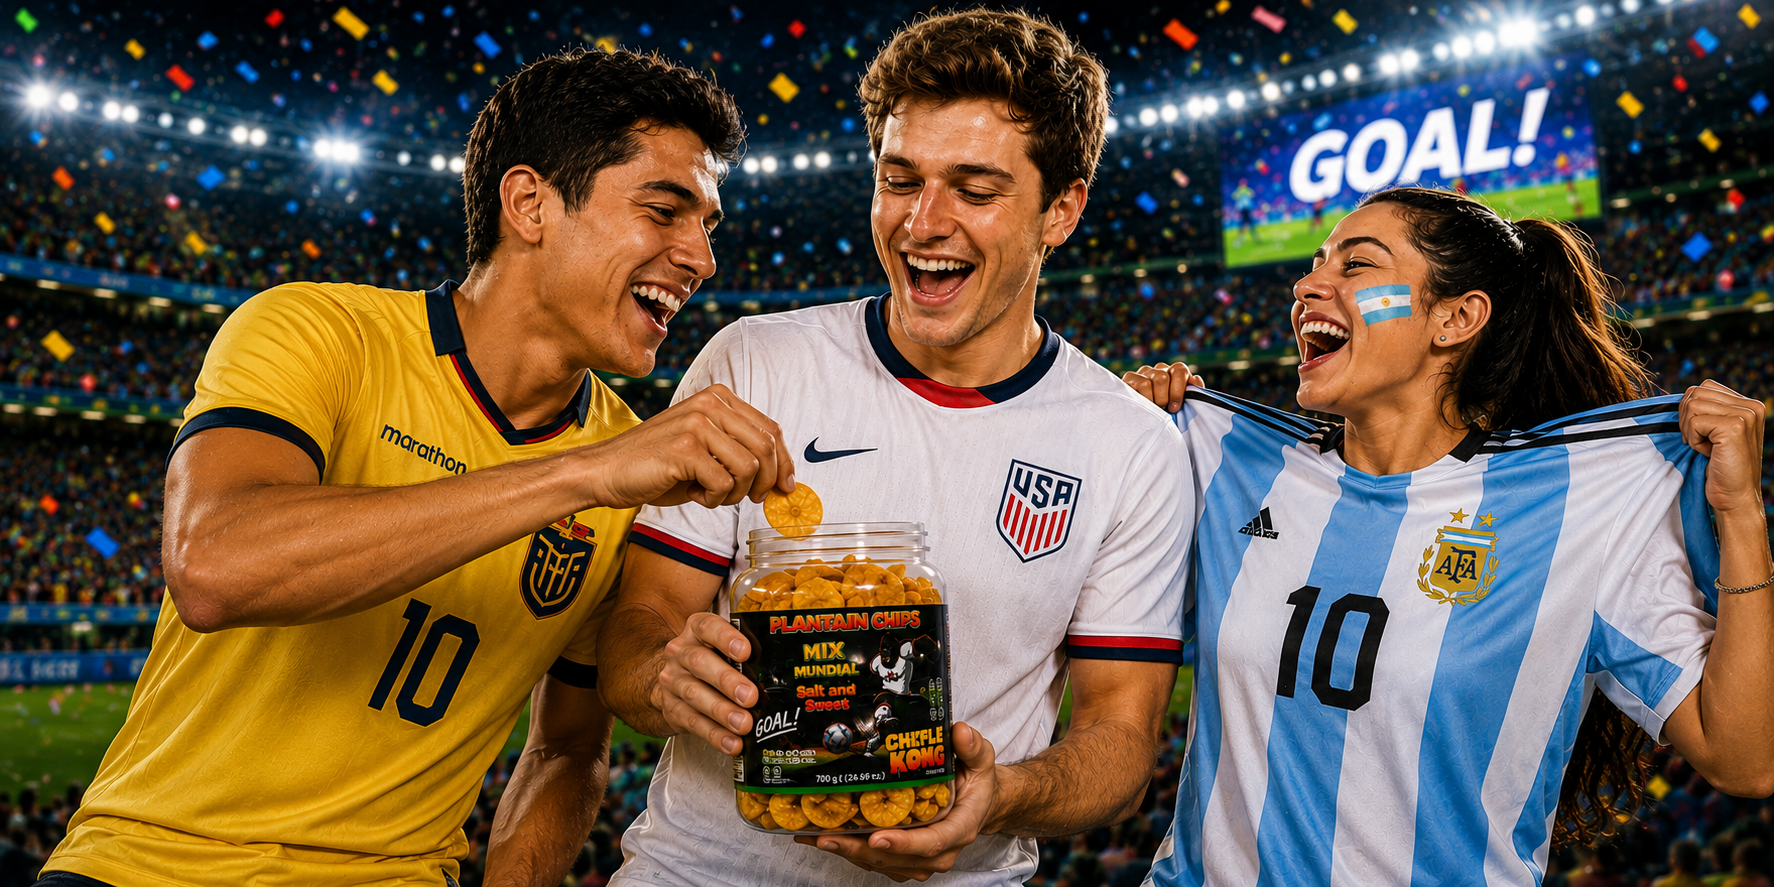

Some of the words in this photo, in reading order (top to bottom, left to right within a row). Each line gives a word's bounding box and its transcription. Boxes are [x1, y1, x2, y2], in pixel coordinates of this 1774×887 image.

[1288, 87, 1550, 203] GOAL!
[380, 424, 467, 475] marathon
[1013, 467, 1074, 509] USA
[1434, 546, 1478, 584] AFA
[769, 611, 869, 634] PLANTAIN
[872, 609, 921, 631] CHIPS
[367, 598, 480, 727] 10
[803, 641, 846, 662] MIX
[1275, 584, 1390, 712] 10
[794, 662, 860, 679] MUNDIAL
[796, 684, 825, 698] Salt
[828, 683, 856, 697] and
[805, 697, 851, 712] Sweet
[755, 706, 801, 738] GOAL!
[889, 744, 945, 774] KONG
[815, 774, 831, 783] 700
